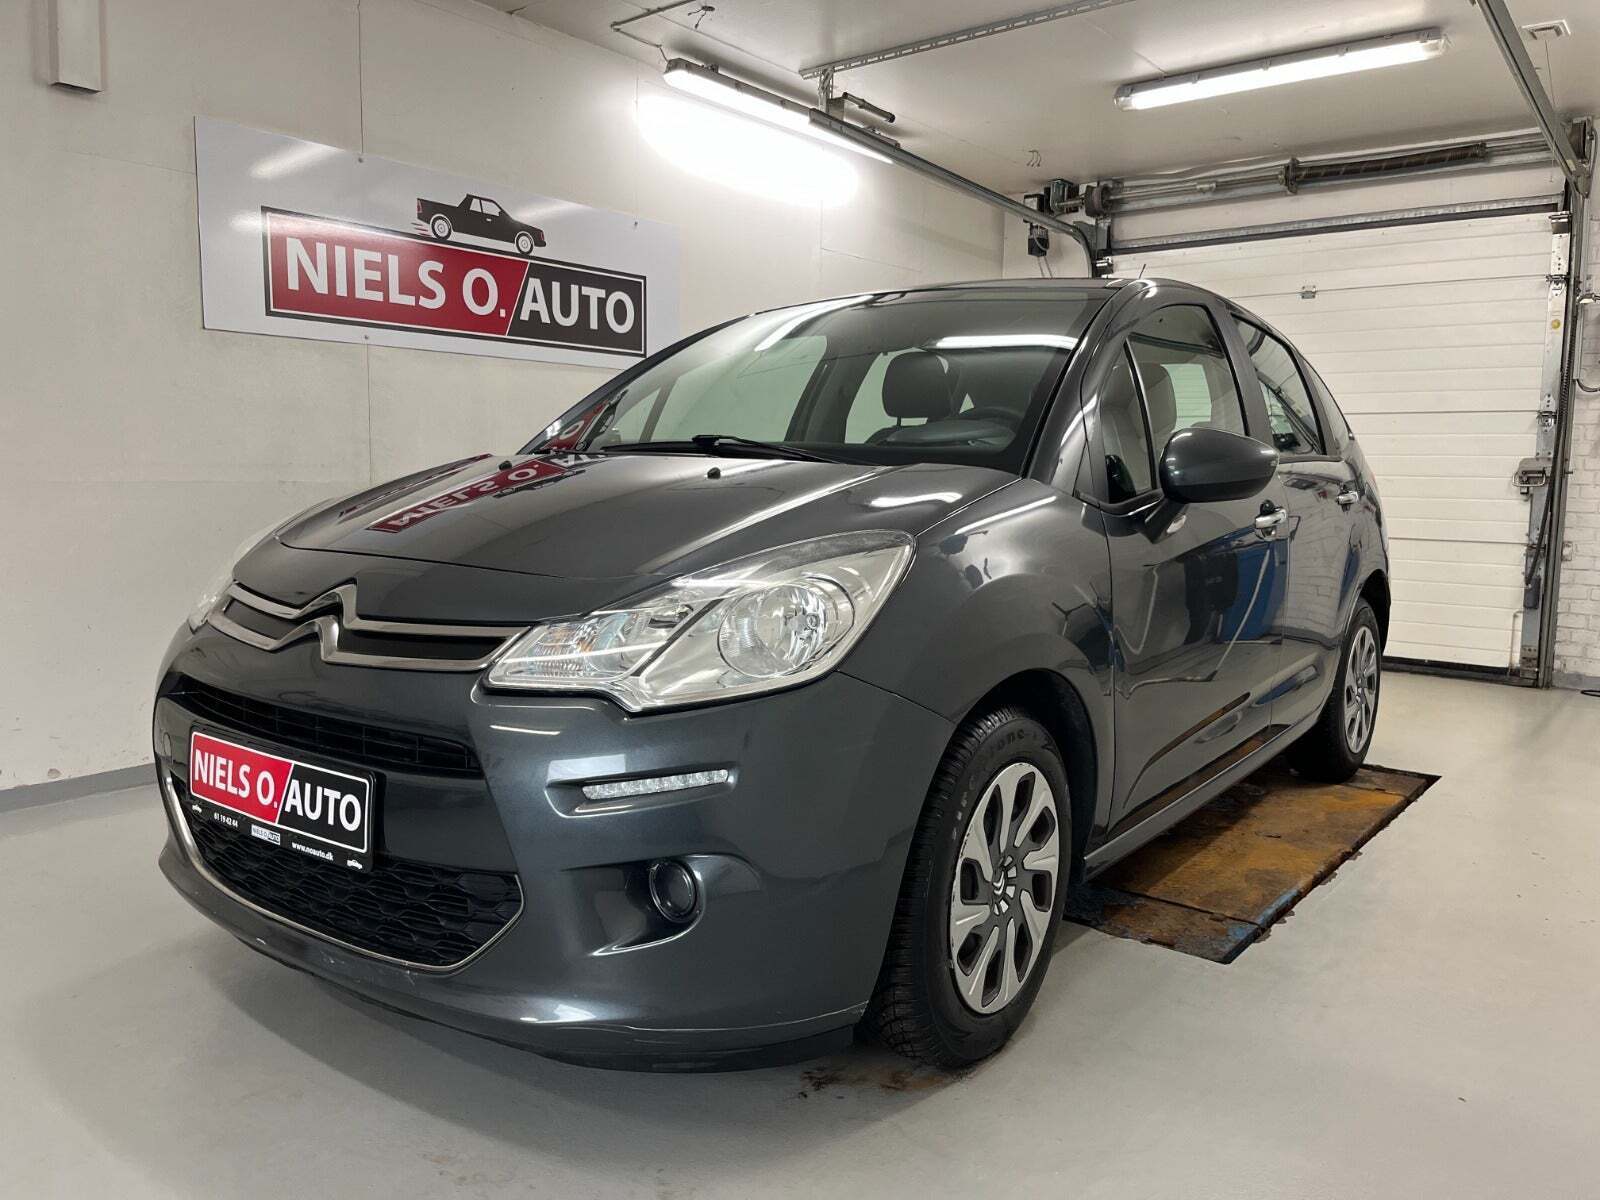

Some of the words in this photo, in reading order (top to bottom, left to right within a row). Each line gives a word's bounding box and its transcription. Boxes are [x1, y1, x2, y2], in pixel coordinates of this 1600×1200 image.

[286, 236, 446, 310] NIELS
[462, 268, 506, 318] O.
[519, 277, 635, 335] AUTO
[194, 748, 251, 798] NIELS
[256, 770, 278, 809] O.
[284, 778, 362, 832] AUTO
[291, 841, 334, 861] www.noauto.dk
